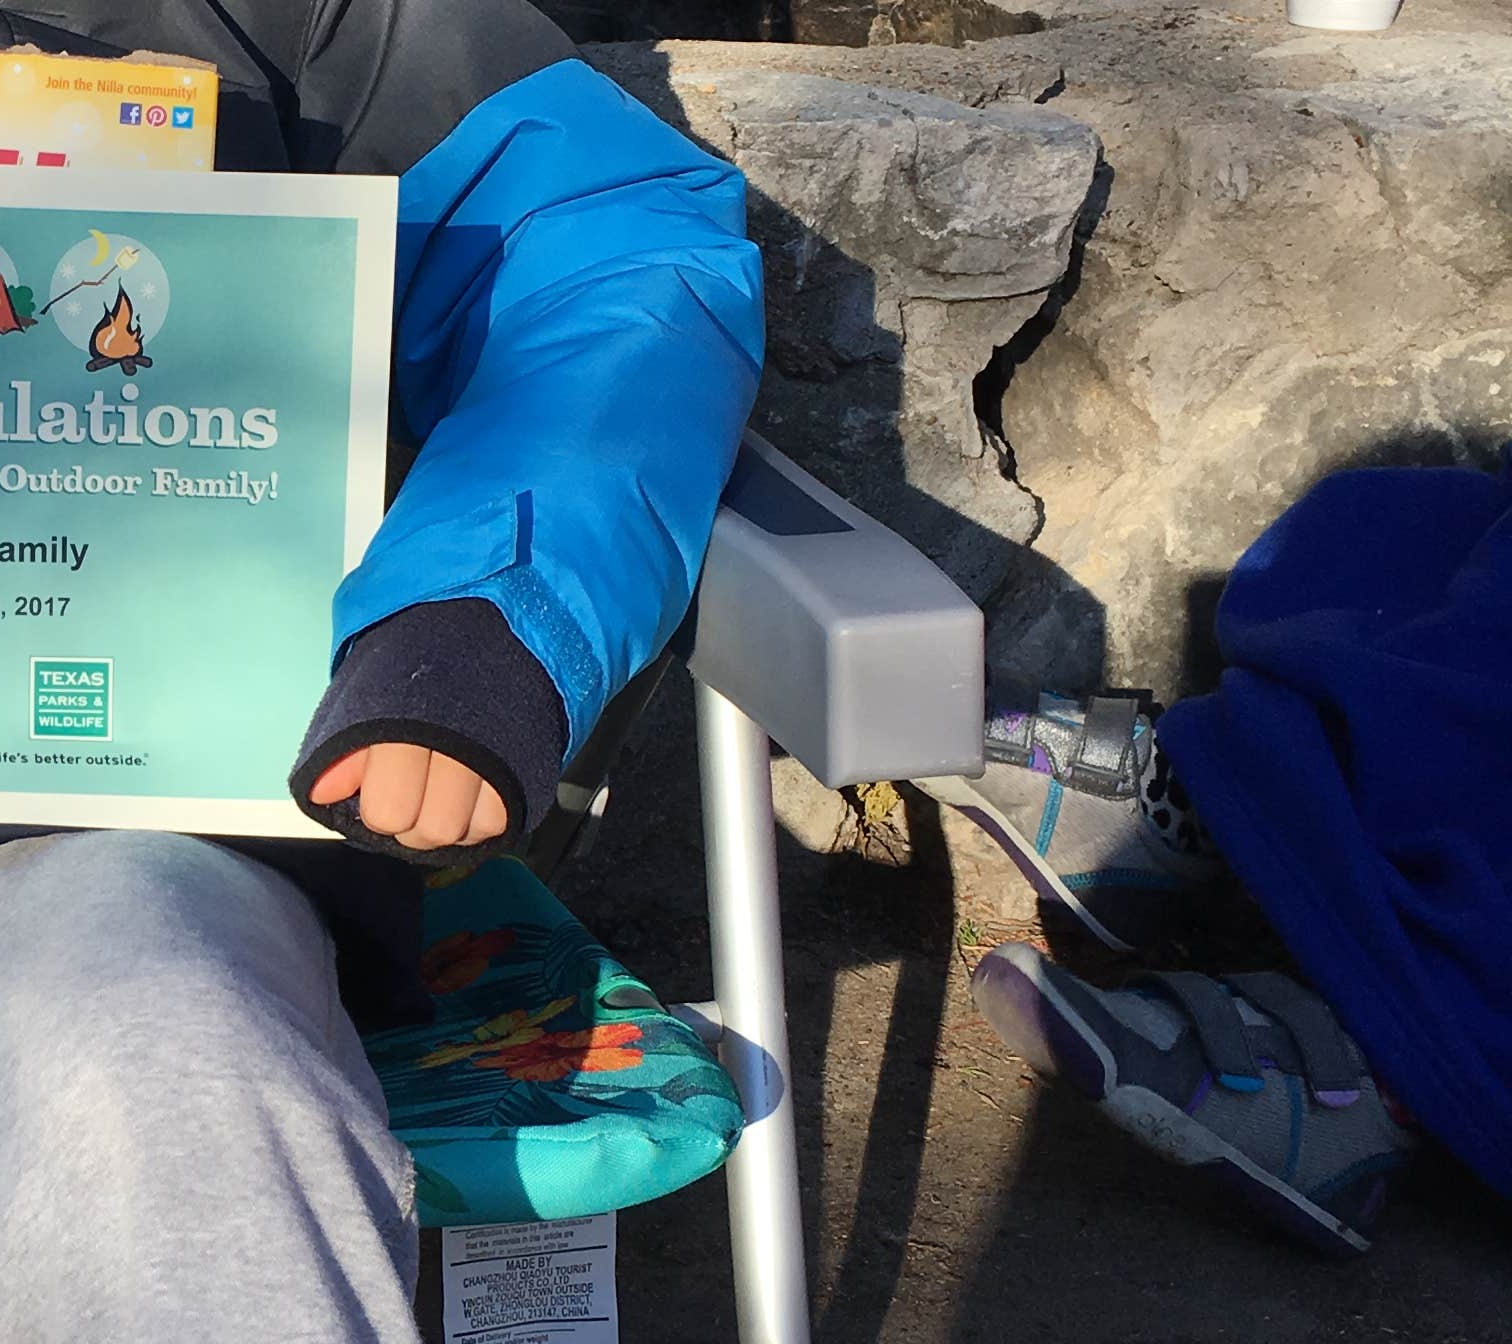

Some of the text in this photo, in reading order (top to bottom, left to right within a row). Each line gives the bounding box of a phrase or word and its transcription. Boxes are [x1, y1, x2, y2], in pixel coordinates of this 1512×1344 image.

[46, 76, 197, 102] Join the Nilla community!
[151, 467, 279, 504] Family!
[14, 596, 71, 617] 2017
[39, 671, 105, 686] TEXAS
[39, 695, 104, 707] PARKS &
[39, 715, 105, 728] WILDLIFE
[34, 753, 82, 766] better
[506, 1256, 553, 1272] MADE BY
[463, 1271, 518, 1288] CHANGZHOU
[555, 1263, 593, 1276] TOURIST
[487, 1278, 534, 1293] PRODUCTS
[527, 1286, 554, 1298] TOWN
[555, 1282, 594, 1296] OUTSIDE
[561, 1305, 590, 1318] CHINA
[478, 1334, 485, 1343] of
[527, 1335, 549, 1344] weight
